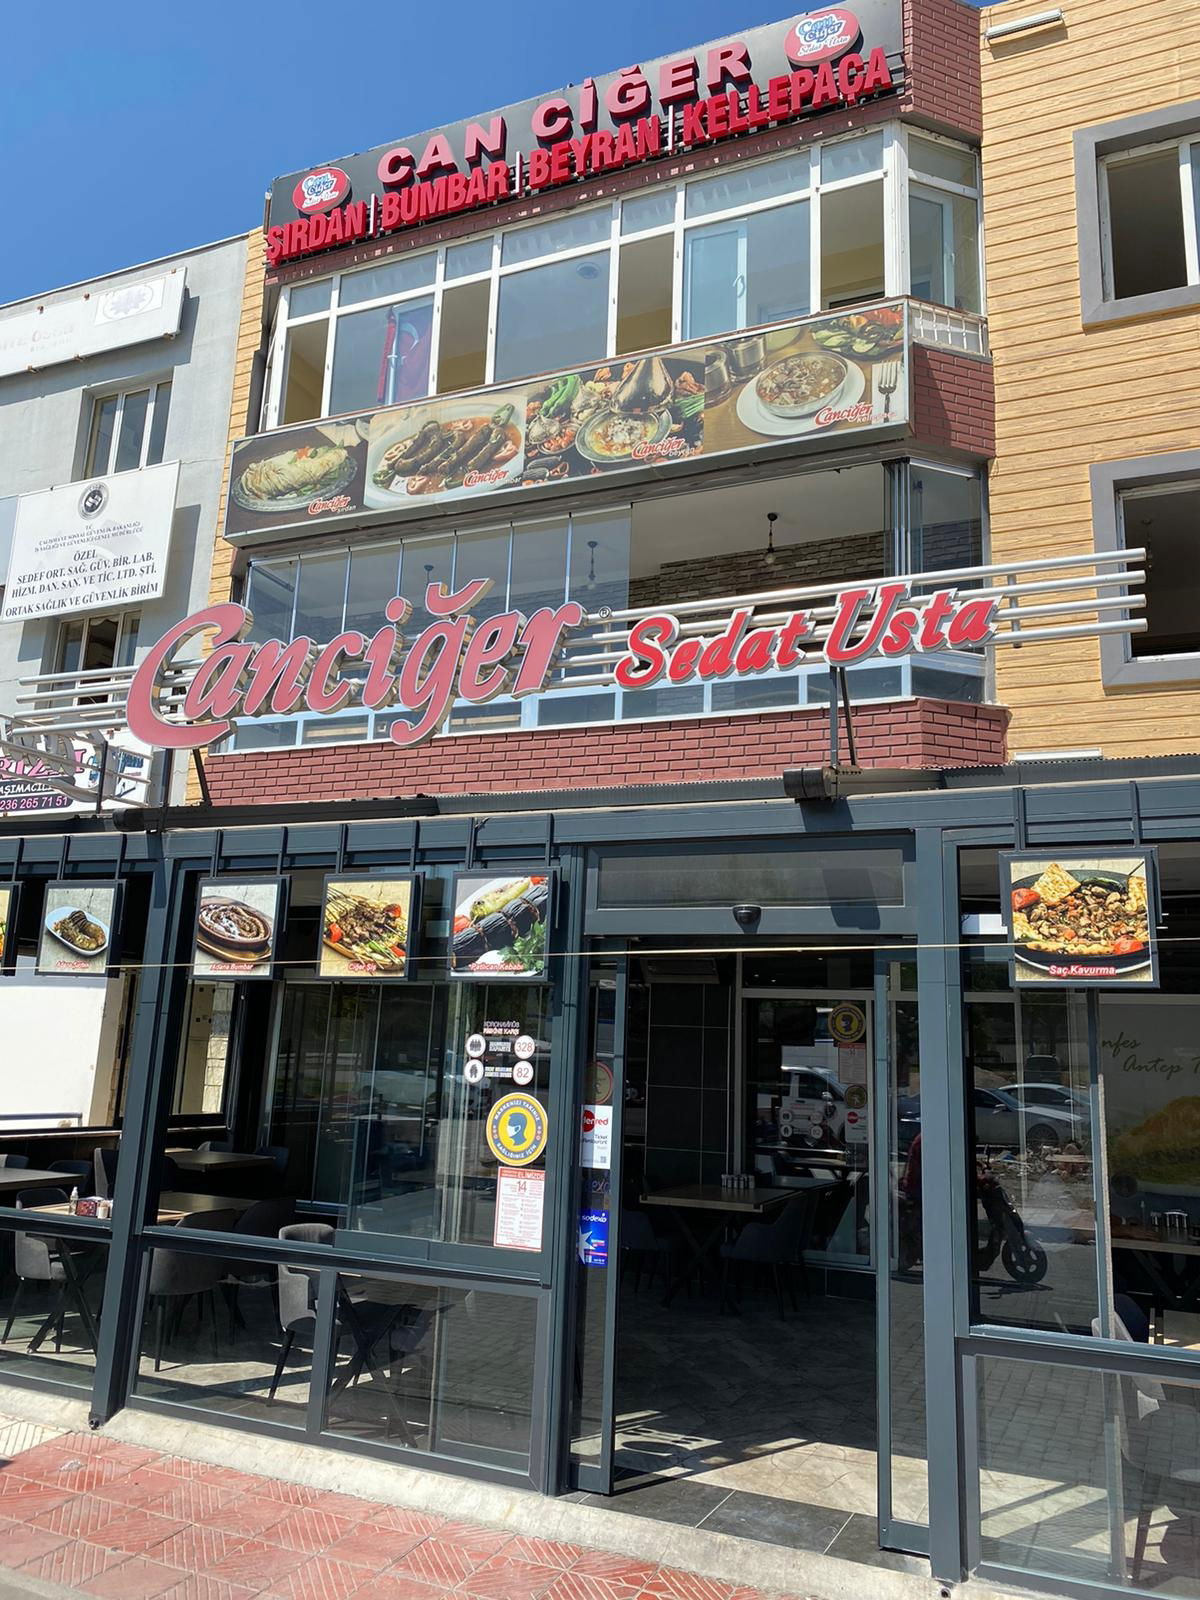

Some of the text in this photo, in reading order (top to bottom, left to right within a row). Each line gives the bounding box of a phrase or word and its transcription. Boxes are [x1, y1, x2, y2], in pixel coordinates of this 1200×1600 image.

[377, 42, 751, 185] CAN CİĞER
[381, 160, 511, 231] BUMBAR
[529, 114, 662, 190] BEYRAN
[683, 47, 892, 146] KELLEPAÇA
[74, 549, 97, 561] ÖZEL
[12, 584, 37, 598] HİZM.
[39, 582, 59, 593] DAN.
[61, 579, 81, 590] SAN.
[83, 575, 96, 584] VE
[117, 568, 137, 579] LTD.
[139, 563, 157, 578] ŞTİ.
[17, 552, 154, 584] SEDEF ORT. SAĞ. GÜV. BİR. LAB.
[5, 582, 159, 617] ORTAK SAĞLIK VE GÜVENLİK BİRİM
[126, 577, 1003, 748] Canciğer Sedat Usta
[20, 797, 39, 809] 265
[41, 796, 53, 807] 71
[56, 795, 68, 806] 51
[1049, 964, 1116, 977] Saç Kavurma
[516, 1042, 533, 1053] 328
[1102, 1032, 1141, 1058] nfes
[516, 1067, 530, 1078] 82
[1123, 1055, 1182, 1080] Antep
[517, 1181, 527, 1192] 14
